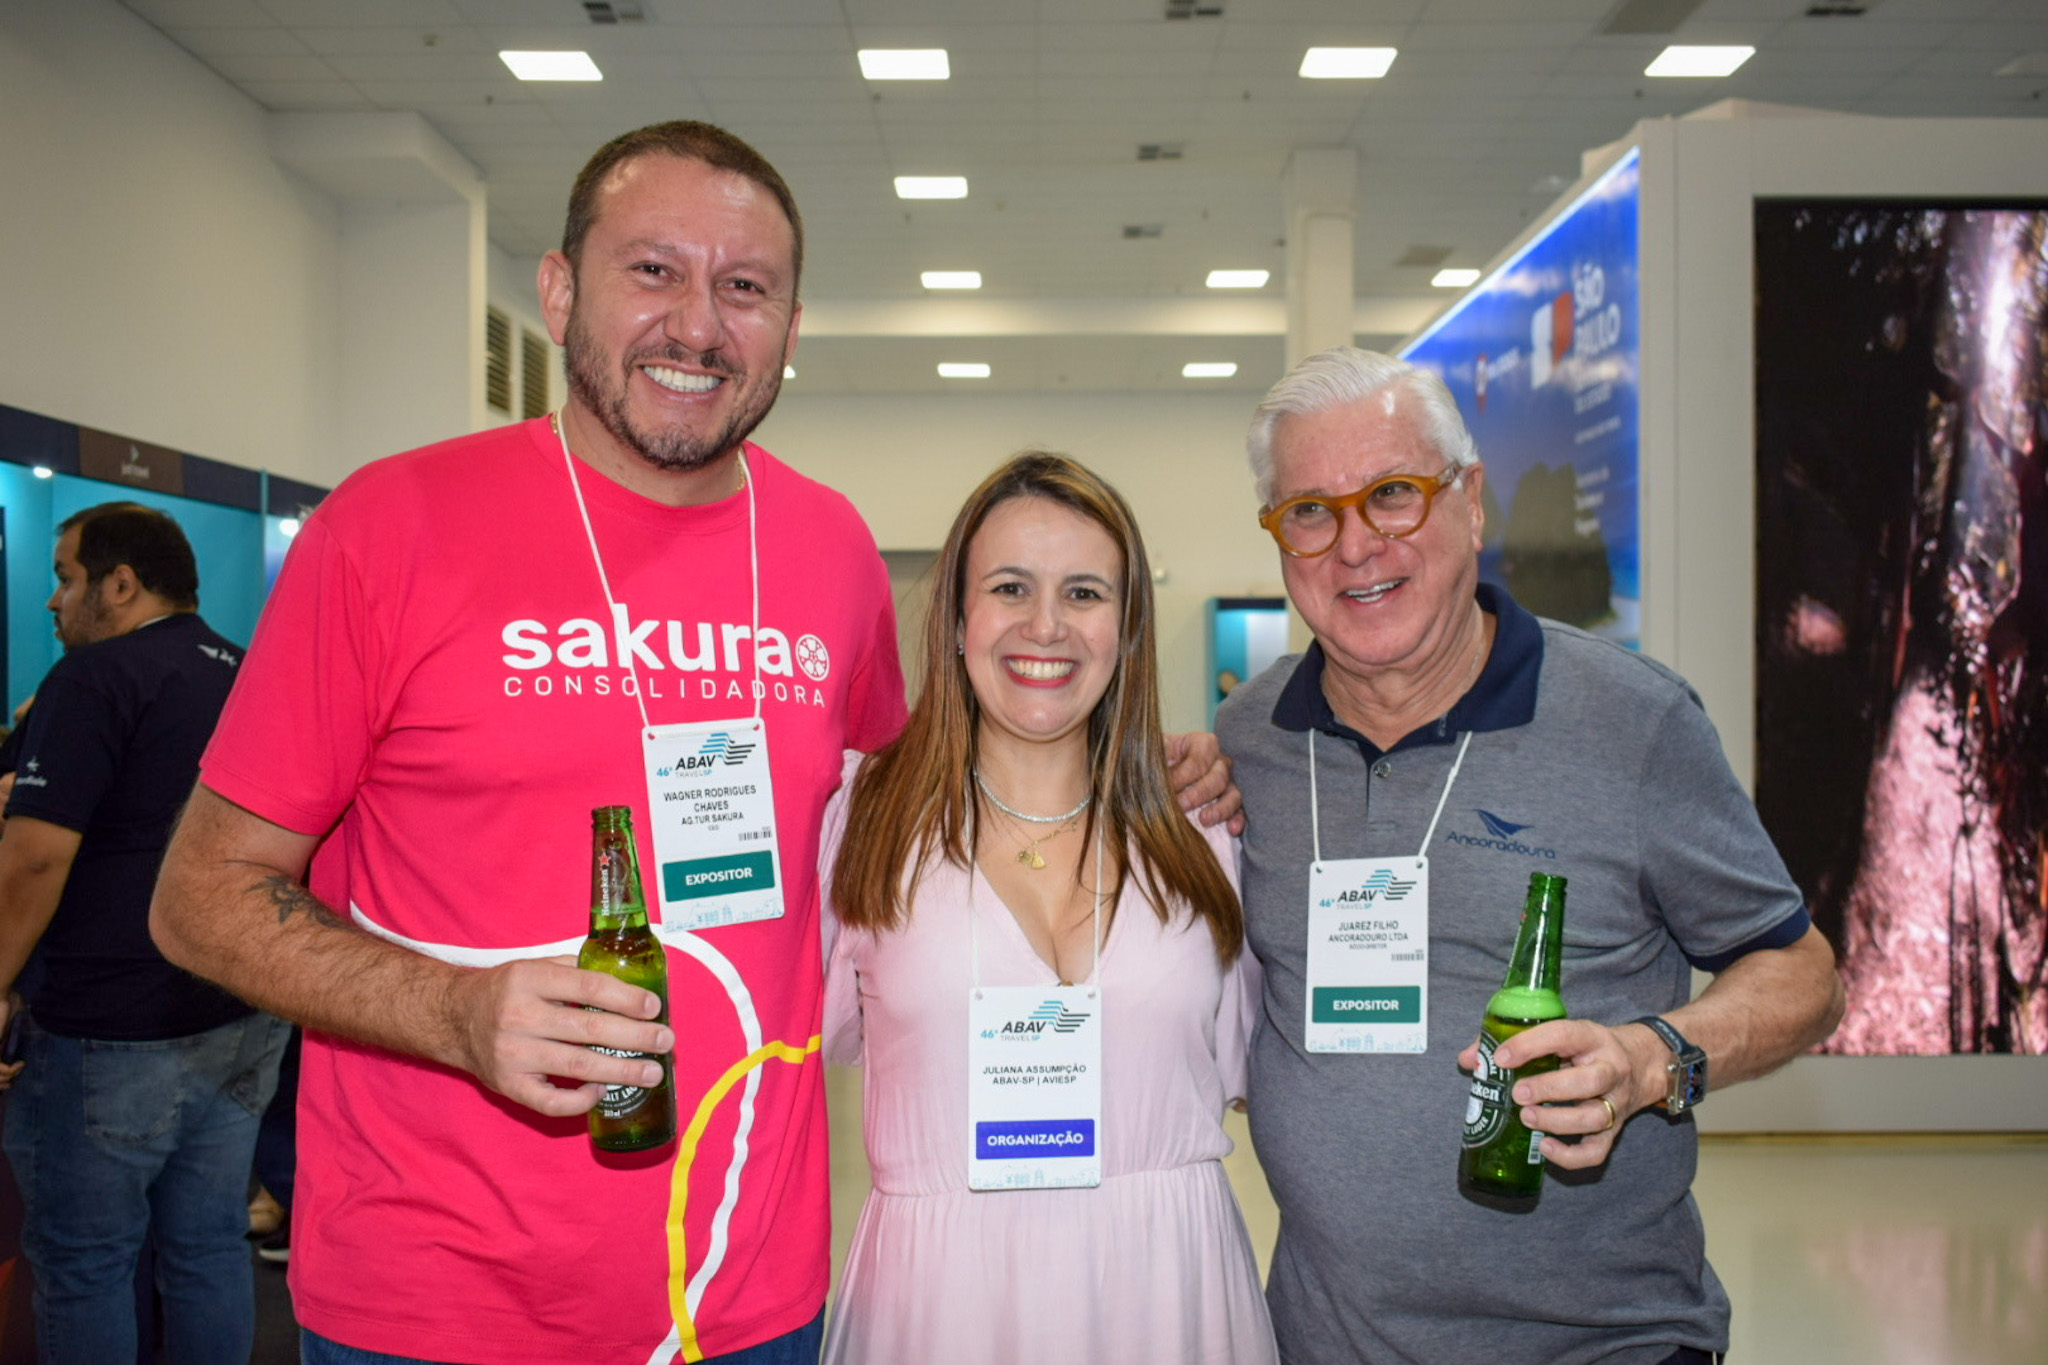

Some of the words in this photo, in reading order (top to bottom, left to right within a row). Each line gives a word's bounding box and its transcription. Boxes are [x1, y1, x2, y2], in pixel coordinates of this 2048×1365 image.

[501, 603, 794, 677] sakura
[504, 675, 826, 708] CONSOLIDADORA
[675, 755, 716, 771] ABAV
[663, 789, 703, 802] WAGNER
[704, 784, 757, 798] RODRIGUES
[693, 800, 729, 812] CHAVES
[711, 812, 744, 823] SAKURA
[685, 867, 753, 886] EXPOSITOR
[1337, 890, 1378, 902] ABAV
[1338, 921, 1372, 931] JUAREZ
[1373, 920, 1399, 930] FILHO
[1327, 933, 1387, 942] ANCORADOURO
[1388, 932, 1409, 941] LTDA
[1333, 1000, 1399, 1011] EXPOSITOR
[1001, 1021, 1047, 1033] ABAV
[983, 1065, 1023, 1075] JULIANA
[1025, 1063, 1087, 1074] ASSUMPÇÃO
[992, 1076, 1035, 1085] ABAV-SP
[1042, 1075, 1077, 1084] AVIESP
[987, 1131, 1084, 1147] ORGANIZAÇÃO
